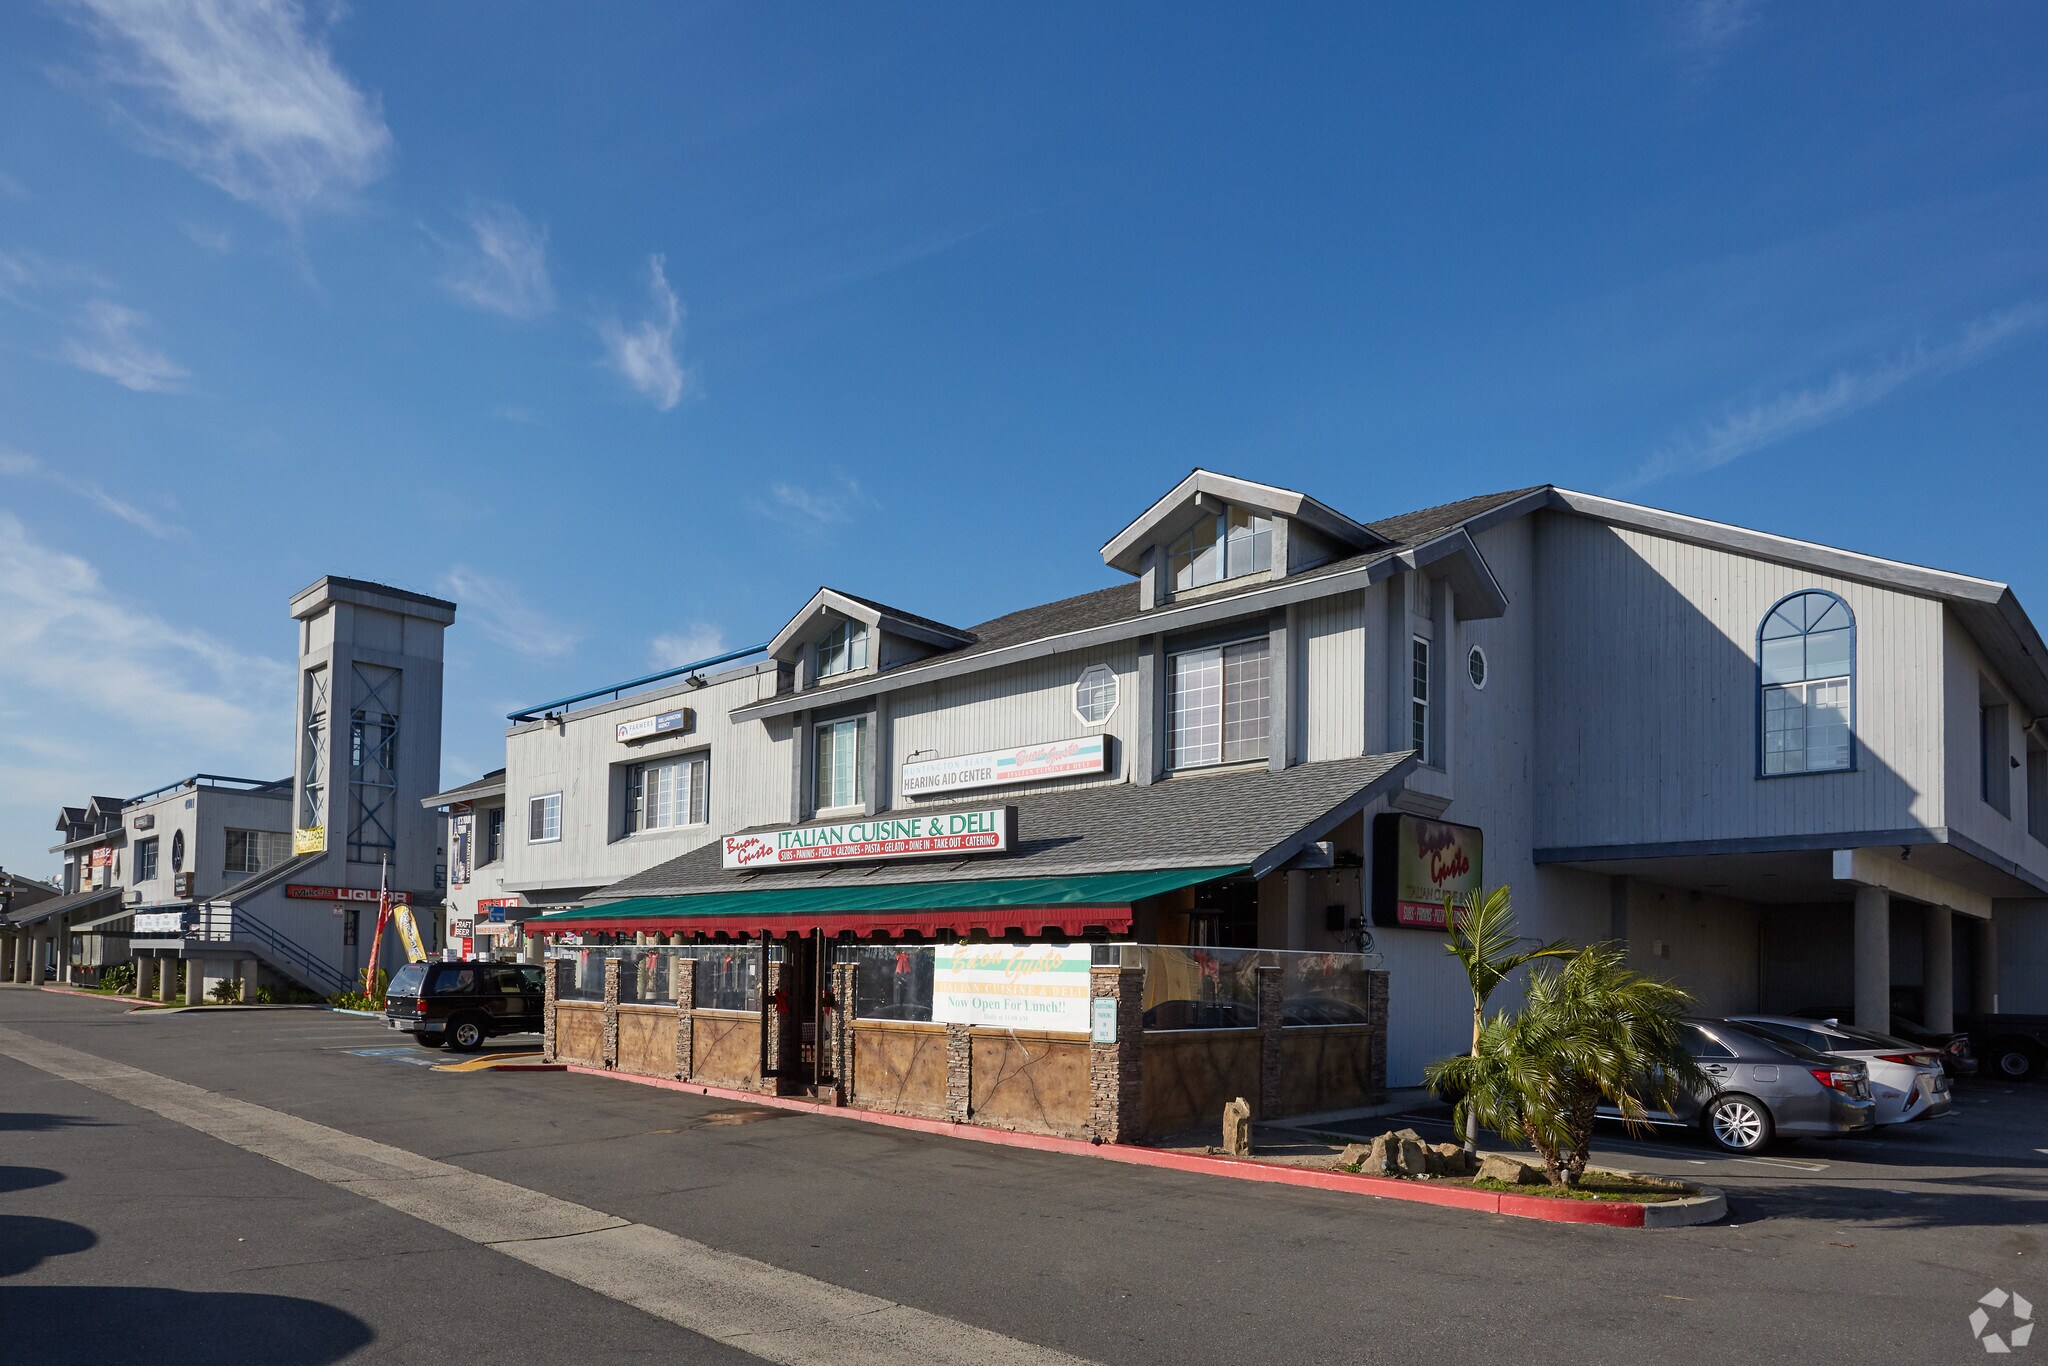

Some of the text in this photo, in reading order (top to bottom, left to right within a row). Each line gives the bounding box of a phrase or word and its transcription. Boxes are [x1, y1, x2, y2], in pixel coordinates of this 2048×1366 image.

[630, 720, 653, 730] FARMERS
[1015, 742, 1079, 768] Buon Gusto
[904, 756, 993, 776] HUNTINGTON BEACH
[1007, 768, 1034, 778] ITALIAN
[1036, 764, 1064, 774] CUISINE
[1072, 760, 1090, 770] DELI
[904, 768, 992, 791] HEARING AID CENTER
[308, 827, 324, 840] LEASE
[778, 812, 995, 850] ITALIAN CUISINE & DELI
[726, 837, 760, 855] Buon
[738, 844, 774, 866] Gusto
[780, 834, 995, 860] SUBS PANINIS PIZZA CALZONES PASTA GELATO DINE IN TAKE OUT CATERING
[1431, 847, 1470, 888] Gusto
[293, 888, 334, 897] Mike's
[1403, 906, 1414, 920] SUBS
[951, 948, 1065, 984] Buon Gusto
[940, 983, 1084, 998] ITALIAN CUISINE & DELI
[948, 996, 1066, 1014] Now Open For Lunch!!
[984, 1013, 997, 1022] Daily
